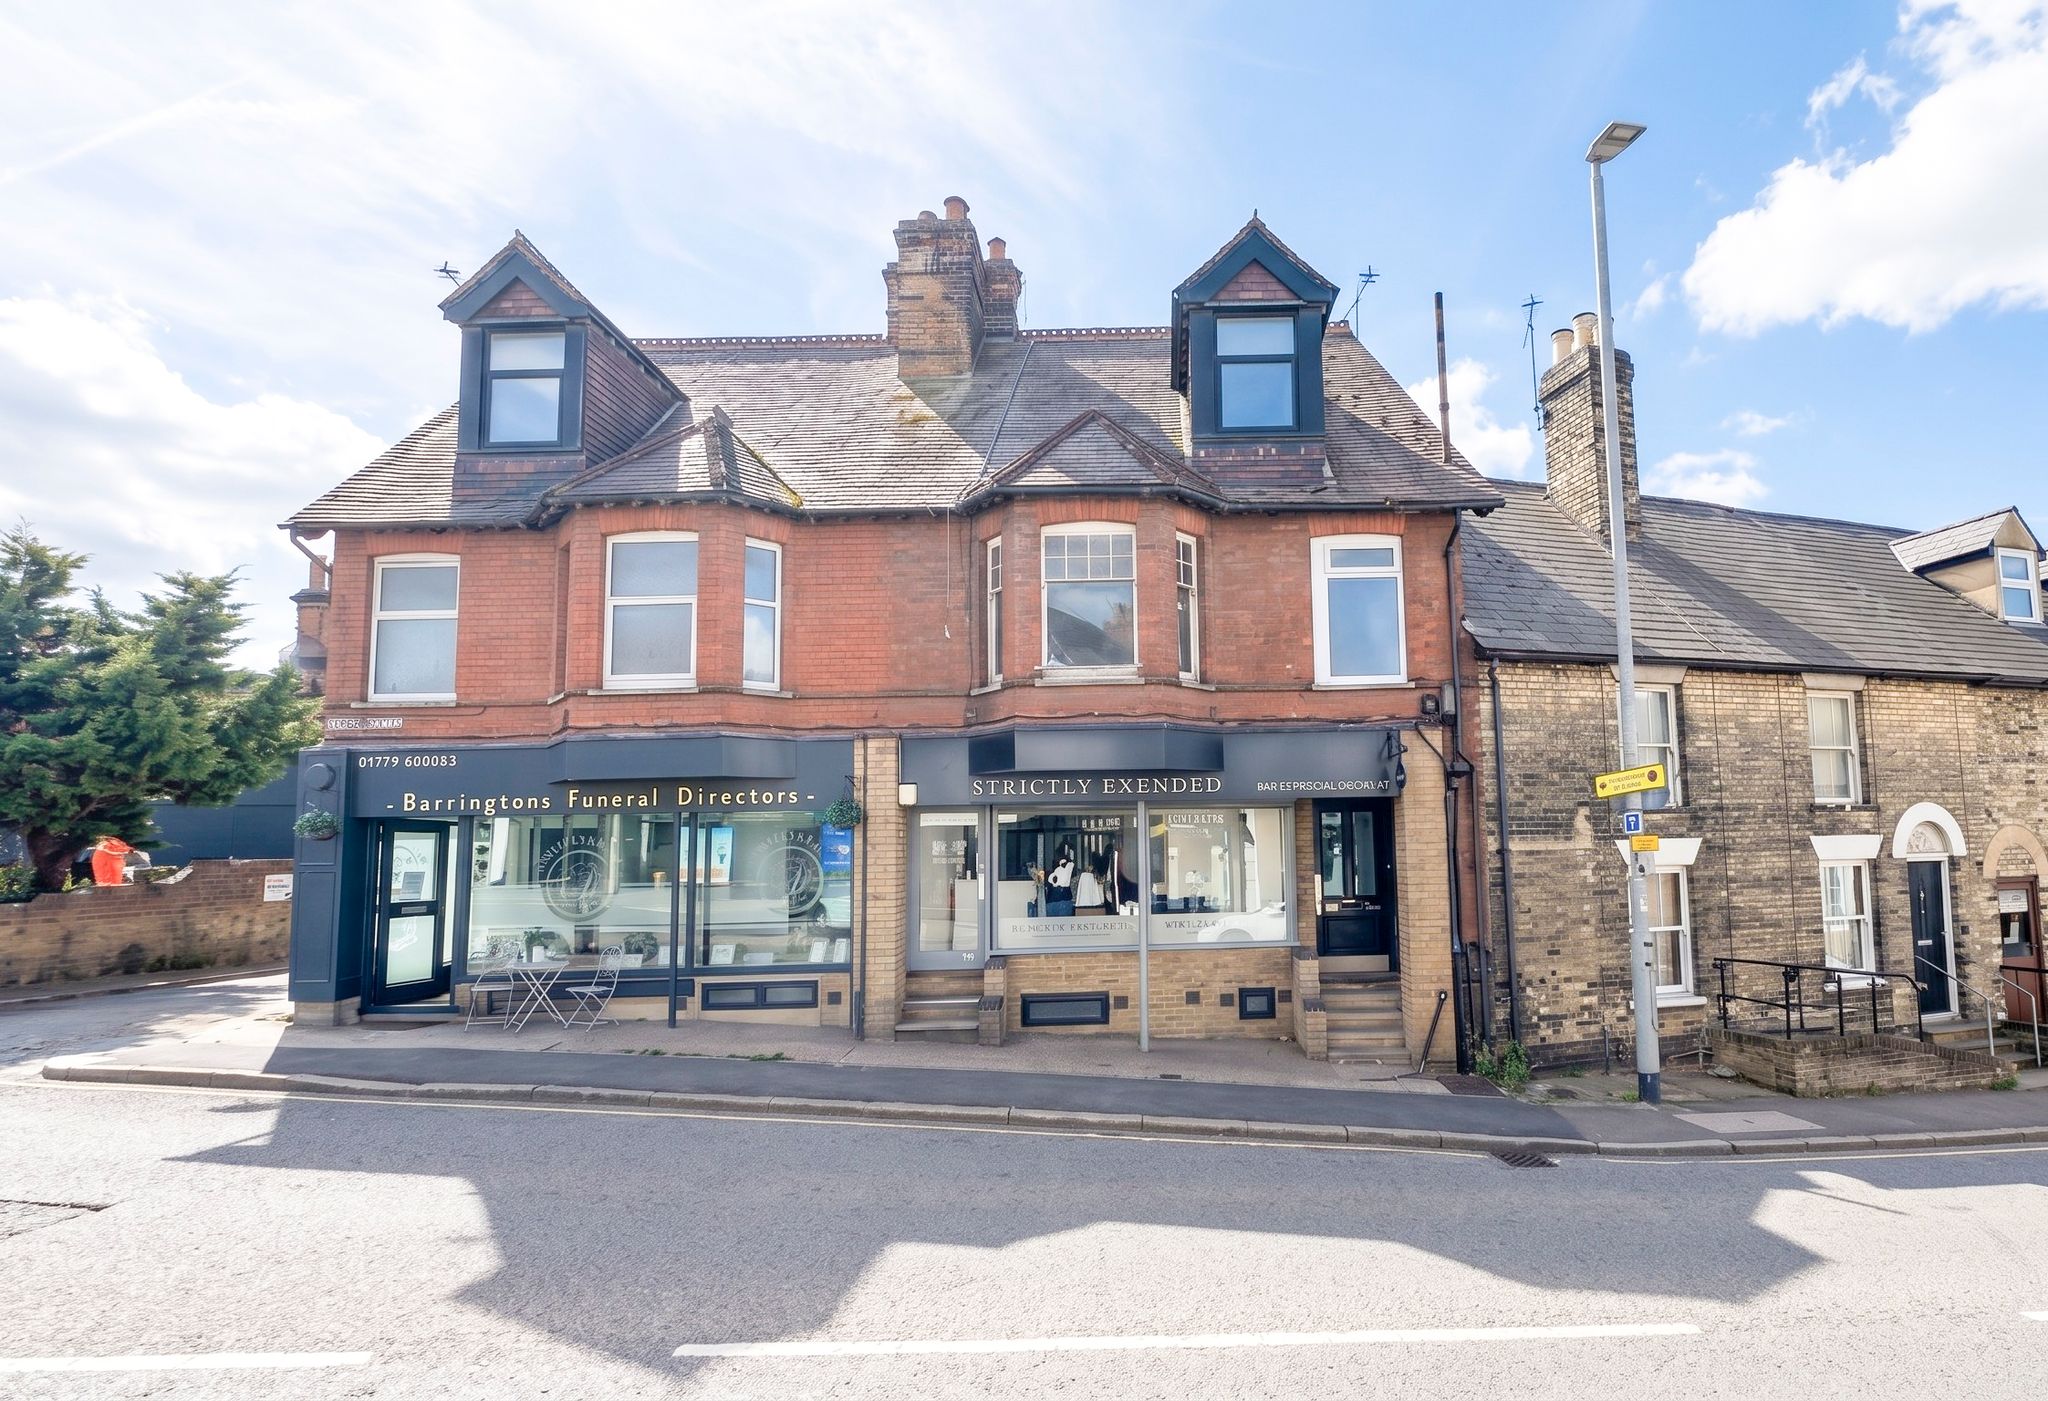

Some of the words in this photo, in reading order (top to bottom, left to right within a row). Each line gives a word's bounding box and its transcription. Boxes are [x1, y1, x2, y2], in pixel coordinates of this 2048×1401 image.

[358, 755, 400, 768] 01779
[404, 755, 457, 768] 600083
[972, 778, 1092, 796] STRICTLY
[1102, 777, 1222, 794] EXENDED
[1257, 781, 1278, 791] BAR
[403, 792, 551, 816] Barringtons
[568, 787, 657, 808] Funeral
[678, 787, 798, 806] Directors
